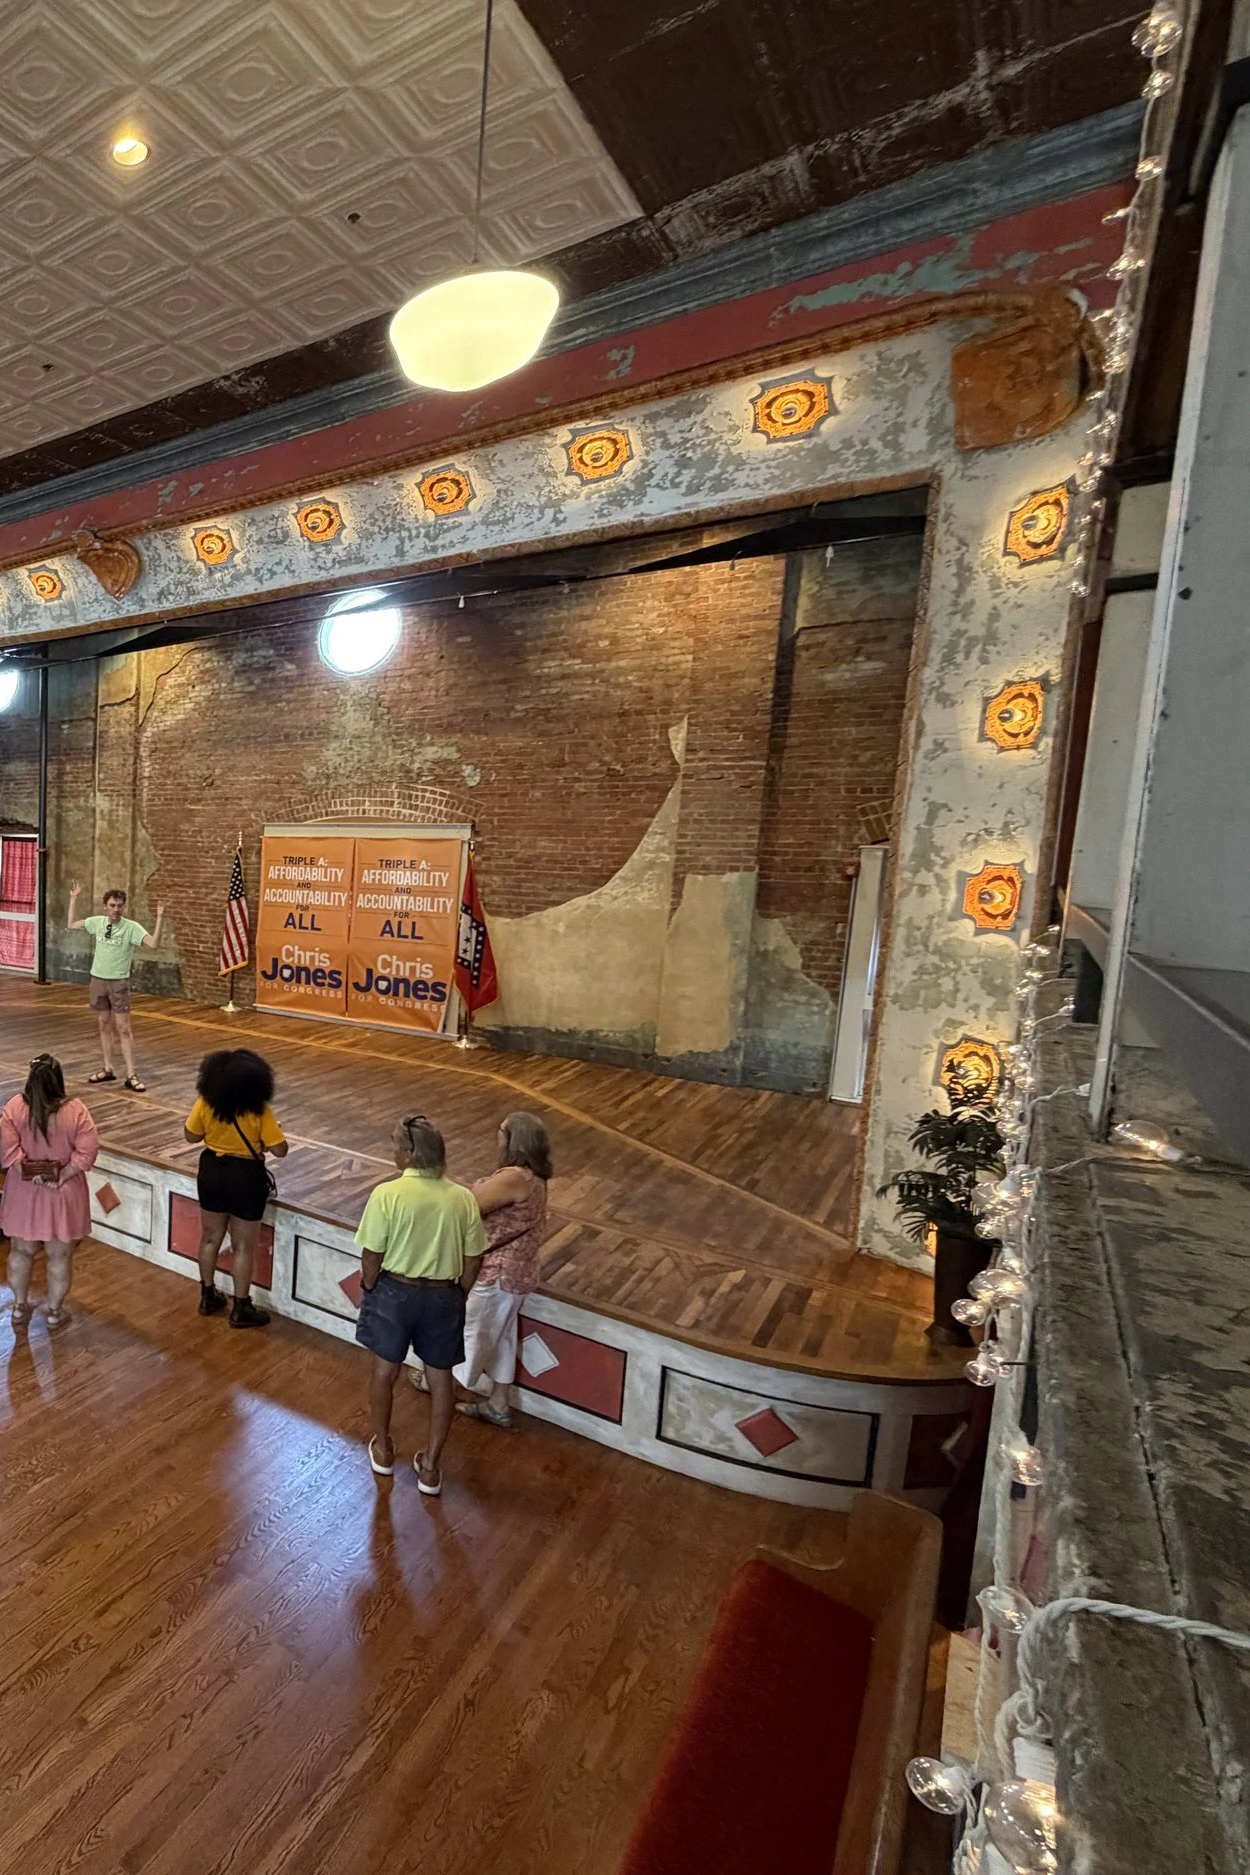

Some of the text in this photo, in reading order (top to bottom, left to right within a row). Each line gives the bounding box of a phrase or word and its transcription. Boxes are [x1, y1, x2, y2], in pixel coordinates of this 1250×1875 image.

[283, 856, 328, 866] TRIPLE A:
[378, 859, 431, 870] TRIPLE A:
[268, 866, 344, 882] AFFORDABILITY
[361, 869, 449, 887] AFFORDABILITY
[264, 889, 348, 907] ACCOUNTABILITY
[357, 894, 454, 913] ACCOUNTABILITY
[284, 913, 322, 931] ALL
[393, 911, 410, 919] FOR
[380, 920, 424, 940] ALL
[282, 945, 330, 967] Chris
[261, 957, 343, 989] Jones
[377, 954, 433, 979] Chris
[260, 981, 343, 999] FOR CONGRESS
[352, 968, 447, 1002] Jones
[351, 993, 447, 1013] FOR CONGRESS
